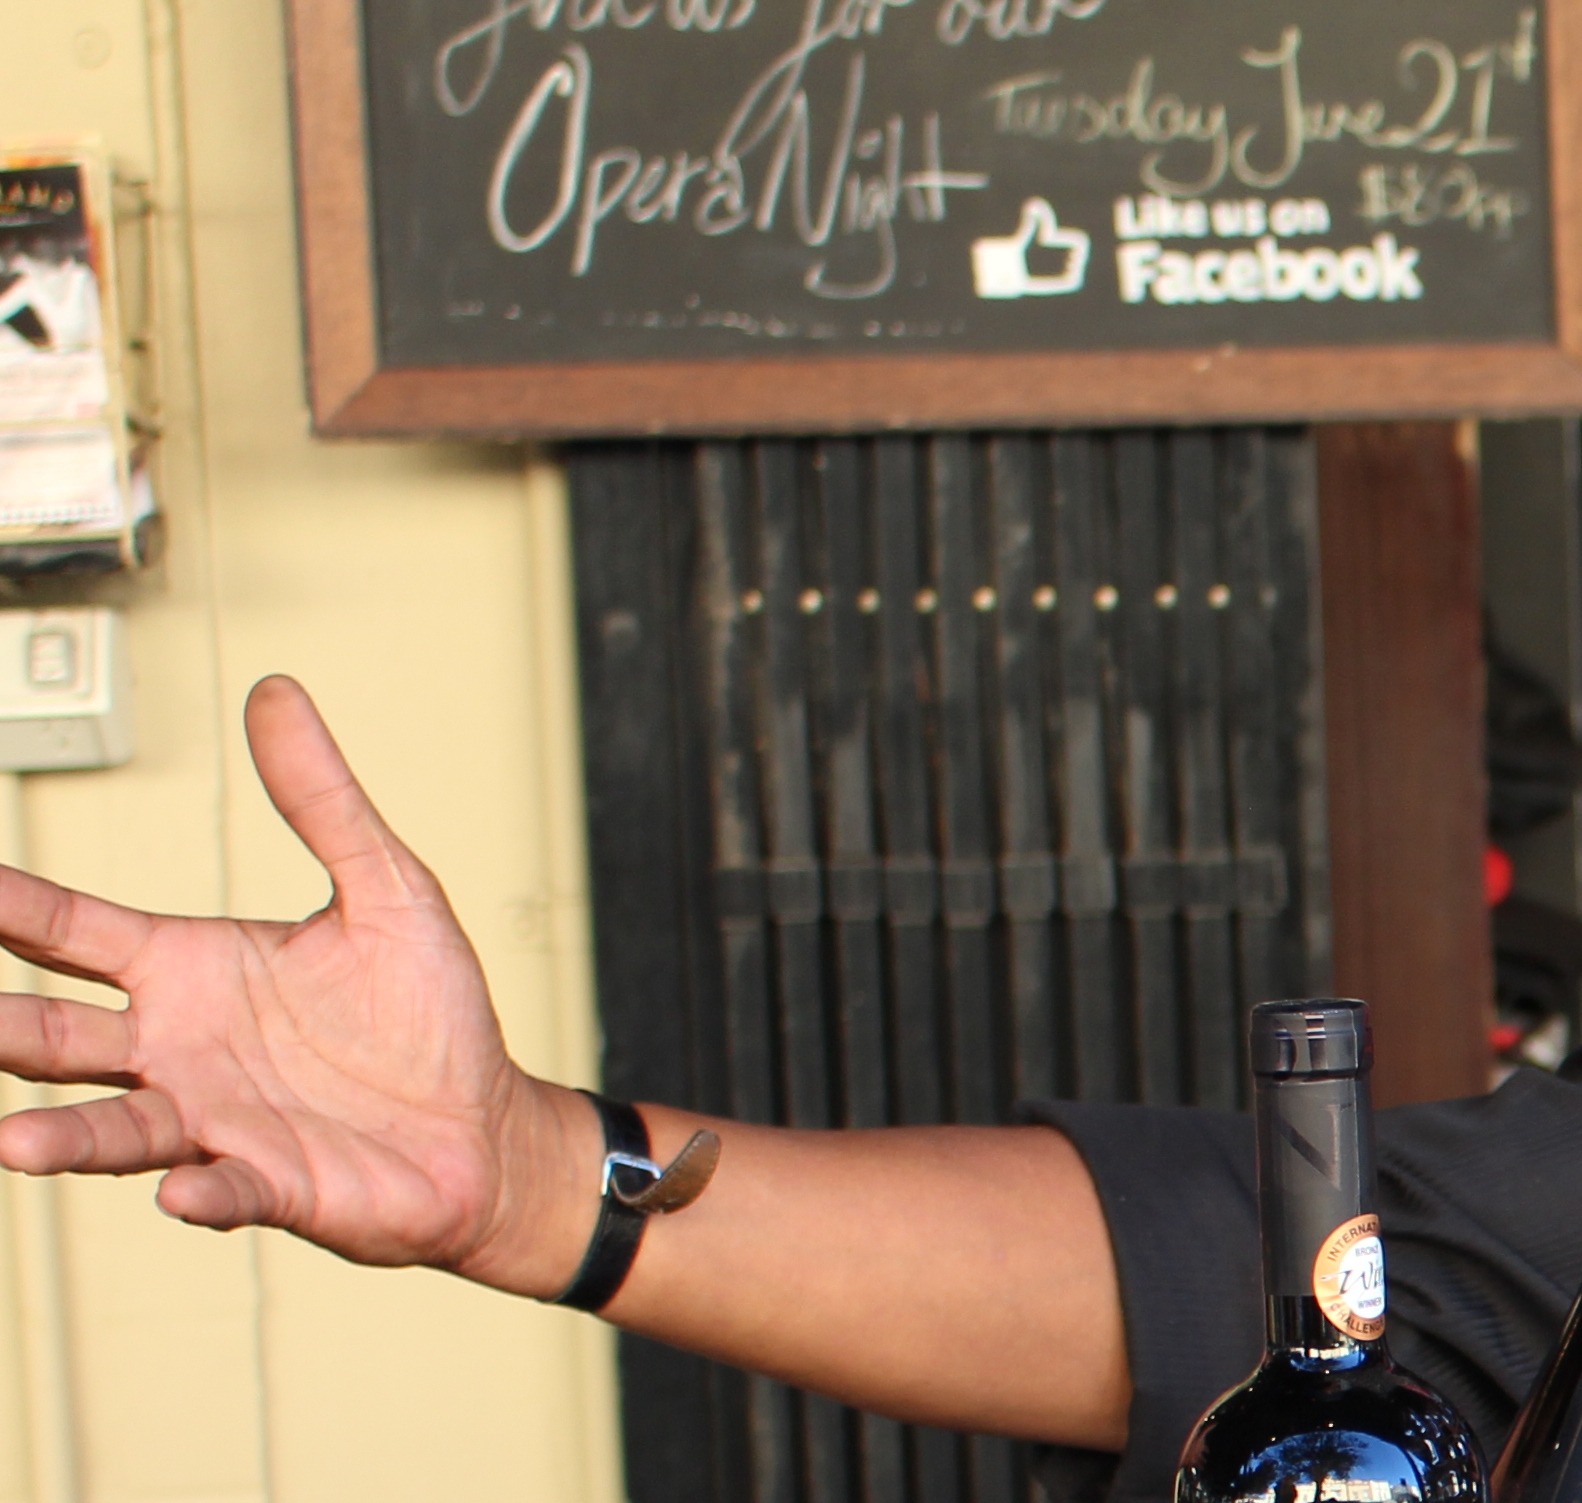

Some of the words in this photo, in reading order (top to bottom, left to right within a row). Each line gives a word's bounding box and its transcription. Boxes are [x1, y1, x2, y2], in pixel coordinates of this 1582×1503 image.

[487, 42, 752, 276] Opera
[757, 50, 990, 299] Night
[1112, 195, 1209, 239] Like
[1211, 201, 1266, 238] us
[1269, 199, 1332, 236] on
[1117, 234, 1425, 304] Facebook
